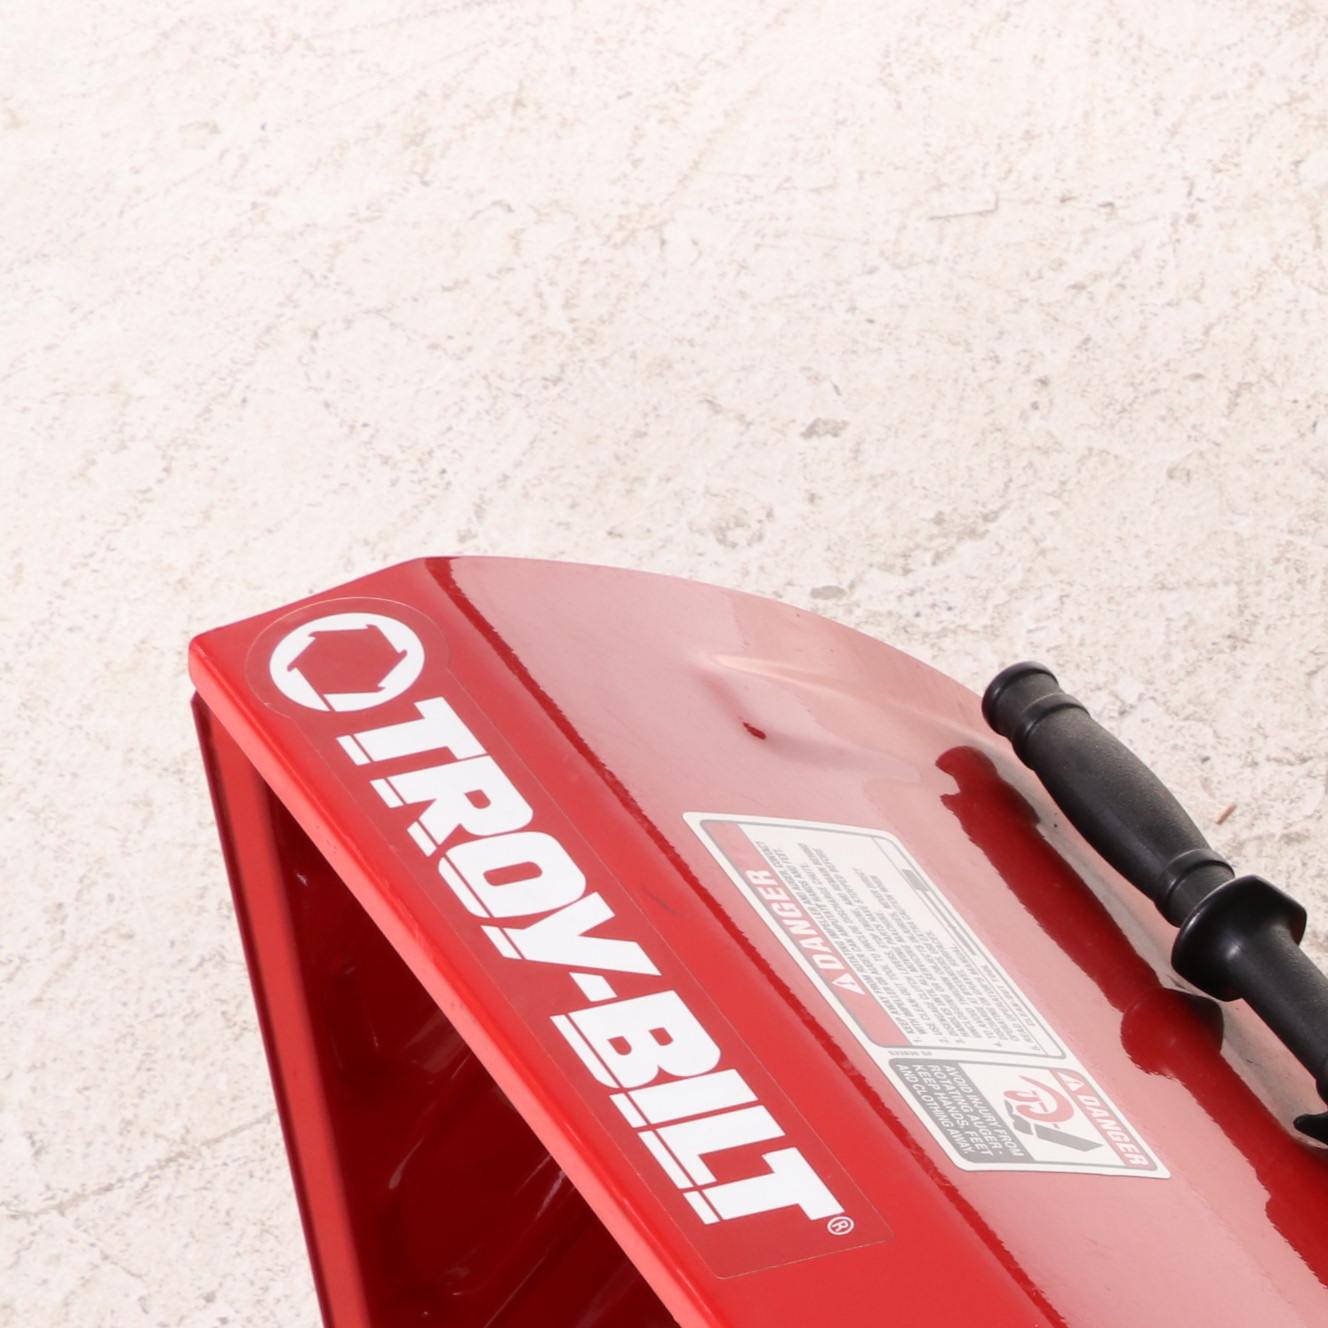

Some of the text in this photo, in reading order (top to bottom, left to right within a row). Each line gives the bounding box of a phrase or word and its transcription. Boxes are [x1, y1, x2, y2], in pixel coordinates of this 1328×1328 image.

[336, 696, 846, 1225] TROY-BILT
[745, 868, 848, 978] DANGER
[896, 1064, 918, 1086] AND
[913, 1082, 954, 1133] CLOTHING
[912, 1064, 940, 1091] KEEP
[964, 1125, 994, 1157] FEET
[927, 1064, 973, 1115] ROTATING
[943, 1065, 1024, 1157] AVOID INJURY FROM
[1077, 1095, 1149, 1166] DANGER
